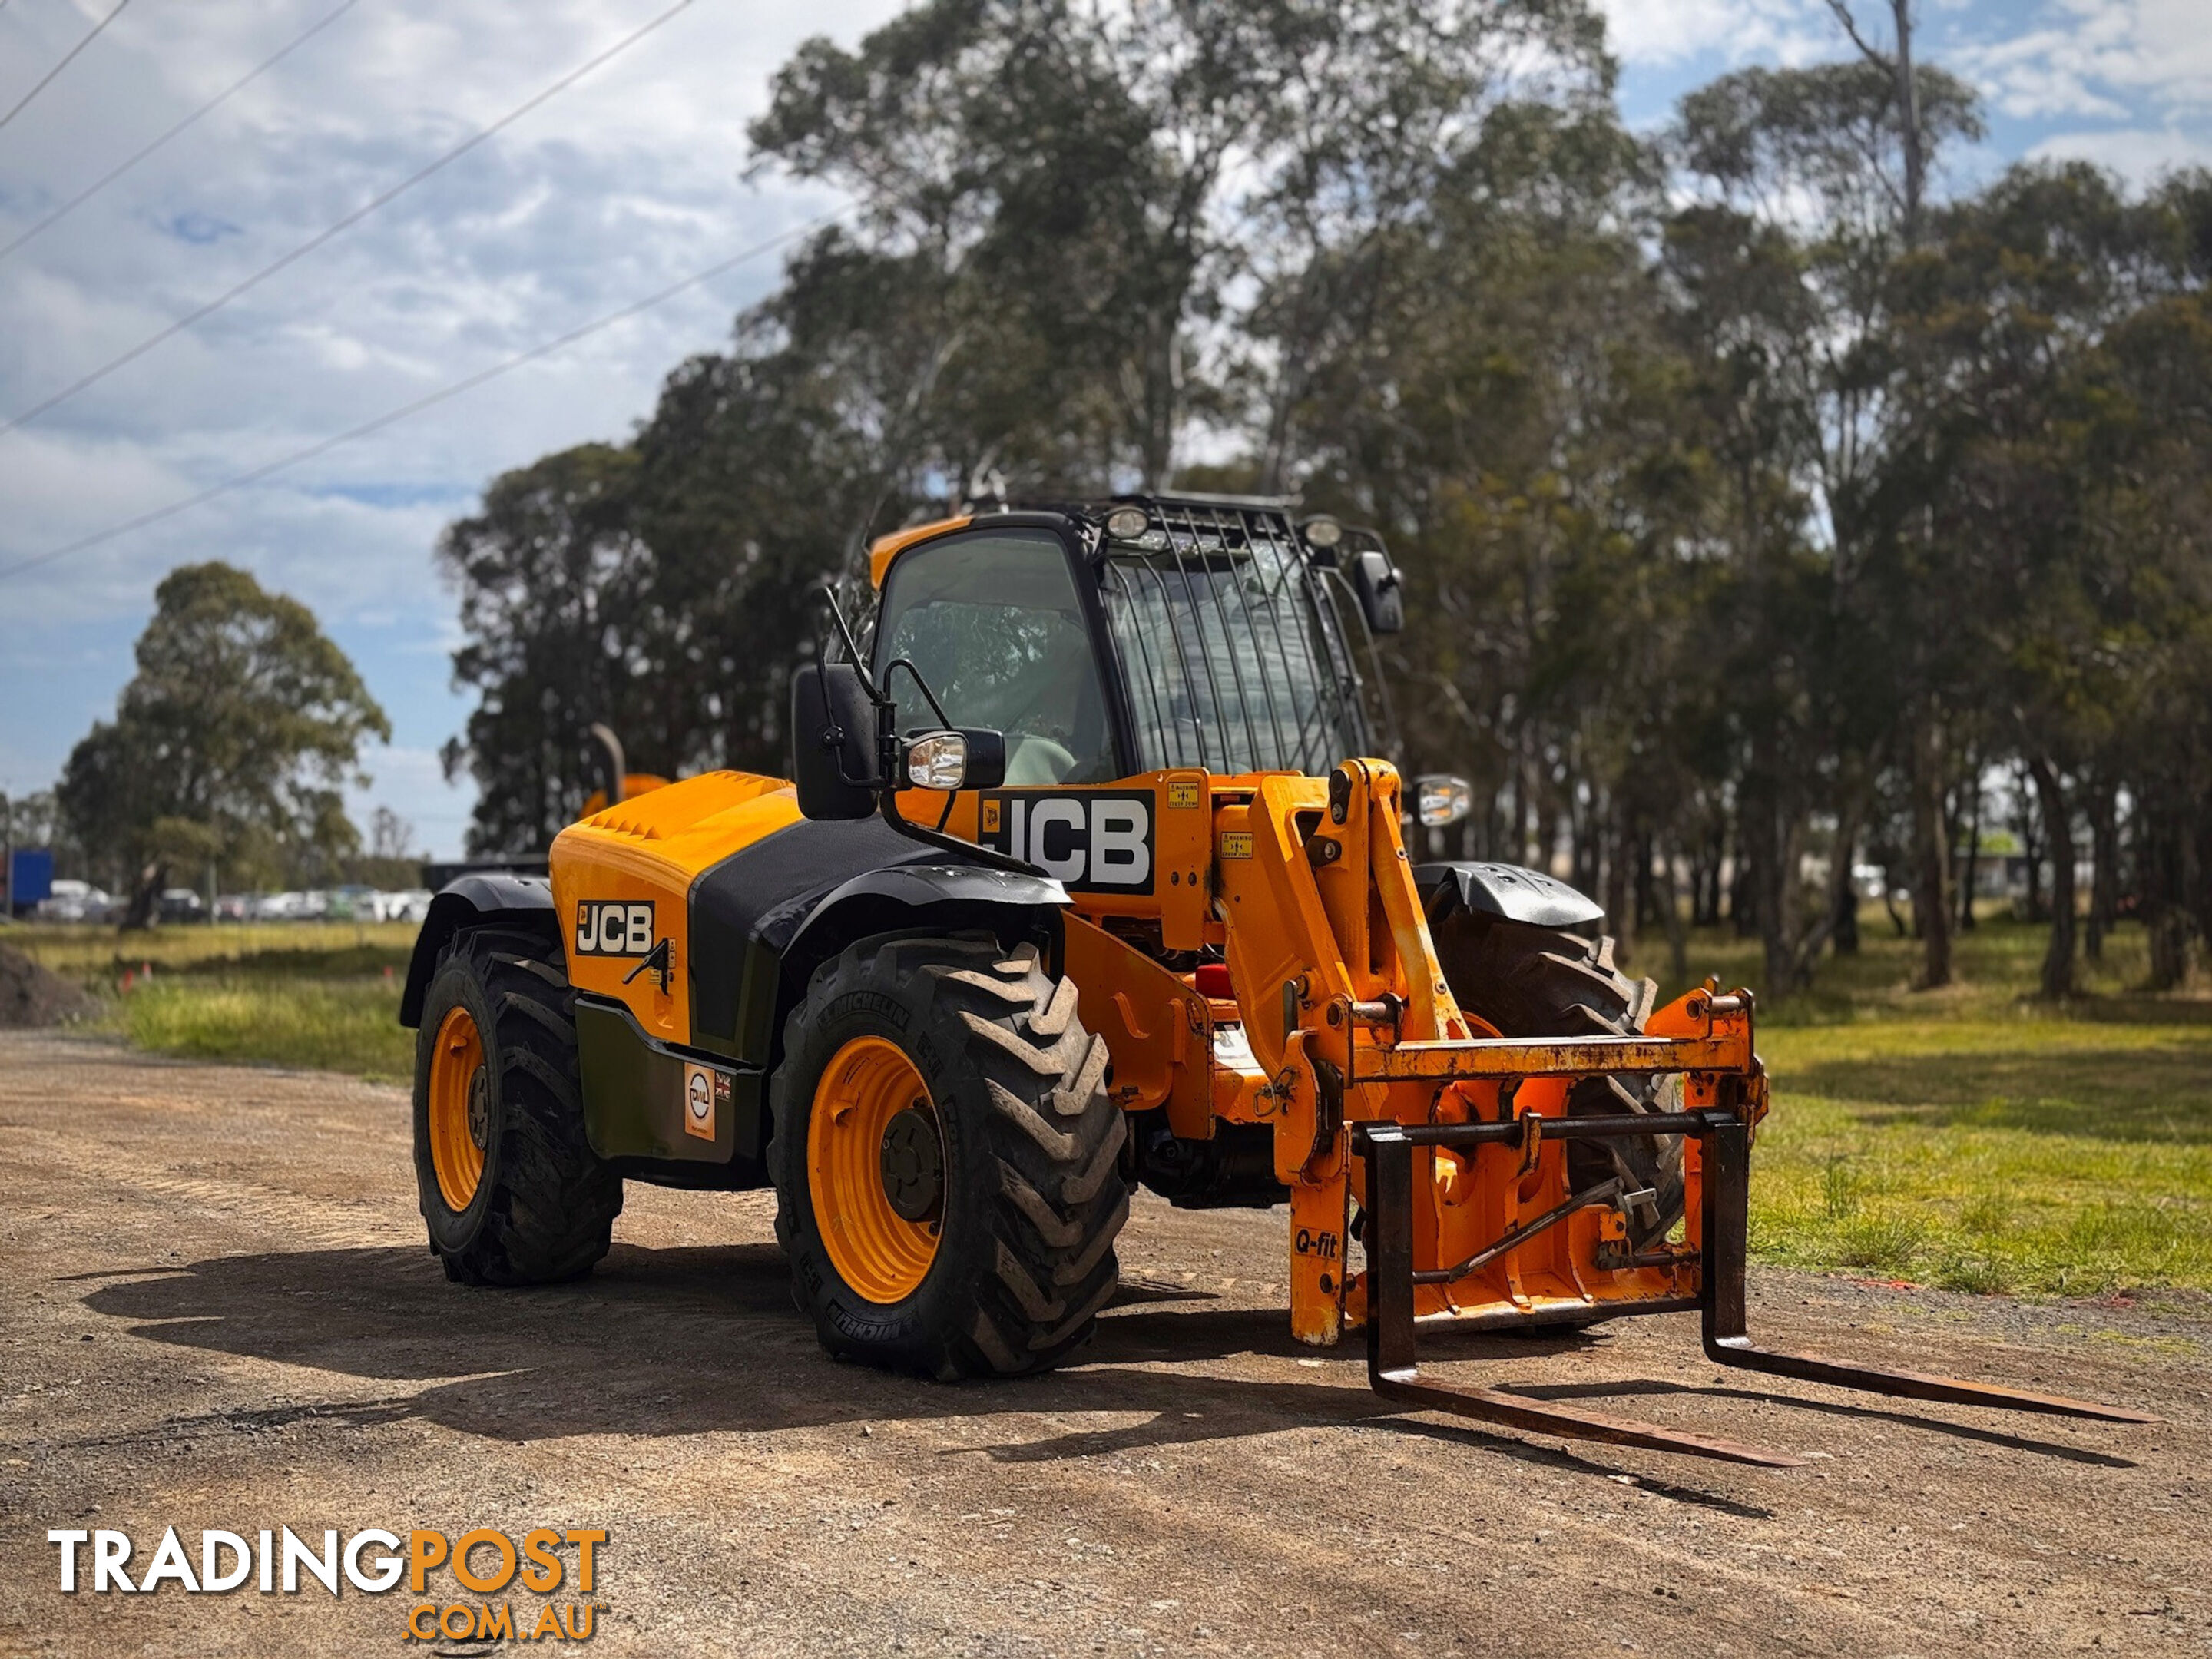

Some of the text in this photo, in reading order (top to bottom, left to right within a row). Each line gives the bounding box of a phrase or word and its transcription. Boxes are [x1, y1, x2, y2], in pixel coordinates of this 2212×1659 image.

[982, 799, 1150, 884] JCB
[578, 905, 652, 952] JCB
[835, 992, 910, 1028] MICHELIN
[1296, 1229, 1337, 1257] Q-fit
[825, 1303, 901, 1341] MICHELIN
